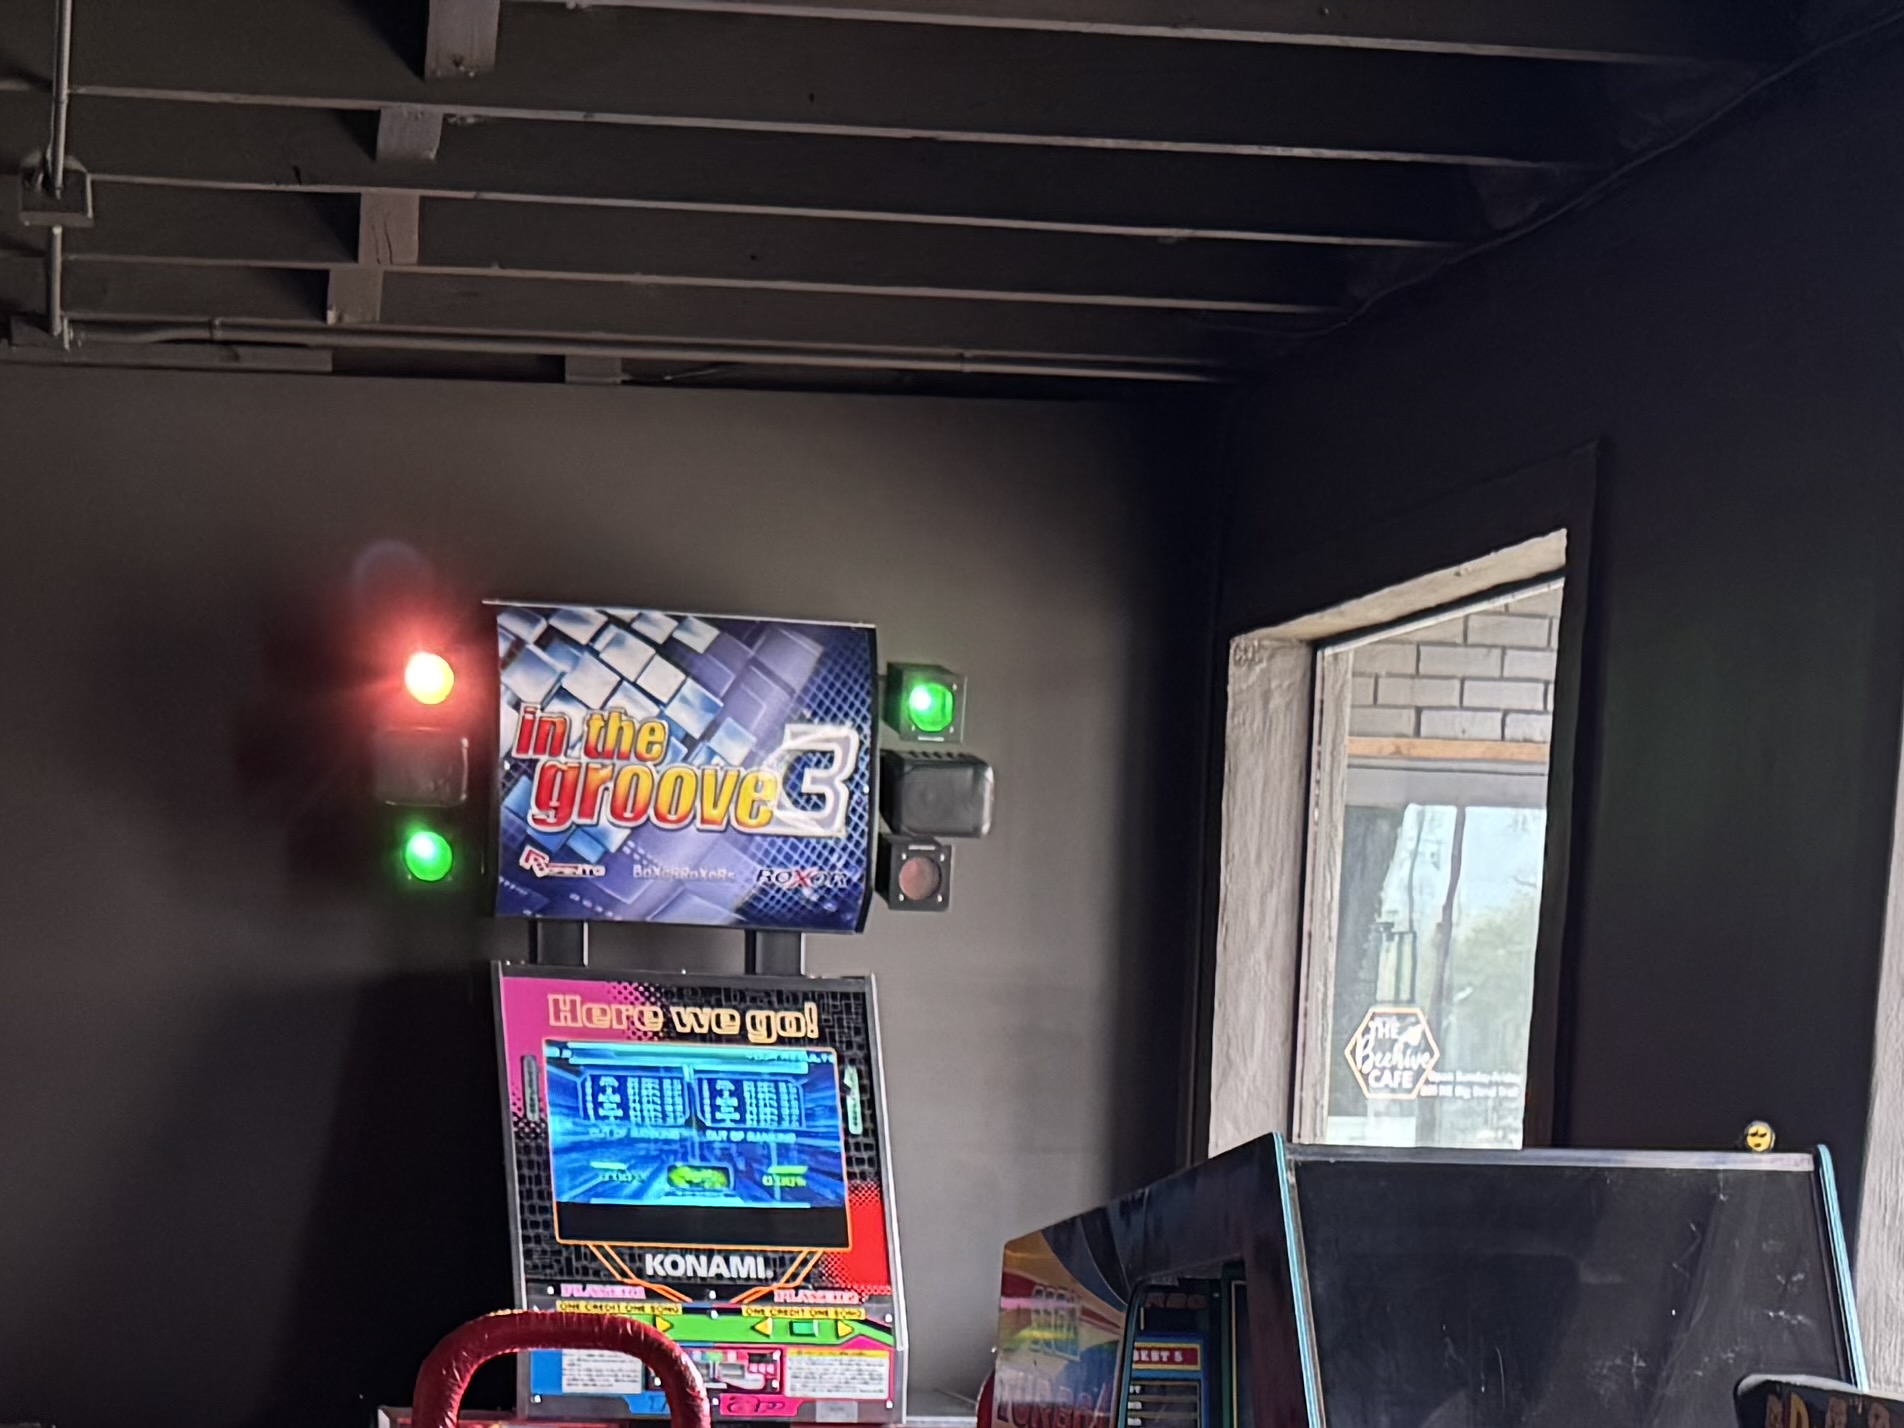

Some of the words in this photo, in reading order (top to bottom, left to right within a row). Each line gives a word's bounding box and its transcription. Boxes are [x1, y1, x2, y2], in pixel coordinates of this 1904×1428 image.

[512, 702, 569, 758] in
[583, 706, 668, 765] the
[528, 761, 779, 833] groove
[771, 723, 859, 838] 3
[756, 867, 848, 888] ROXOR
[547, 993, 664, 1033] Here
[670, 1001, 741, 1037] we
[746, 1002, 820, 1044] go!
[1367, 1017, 1400, 1040] THE
[1355, 1034, 1431, 1073] Beehive
[1368, 1070, 1414, 1089] CAFE
[645, 1252, 769, 1280] KONAMI
[585, 1303, 621, 1313] CREDIT
[769, 1308, 805, 1317] CREDIT
